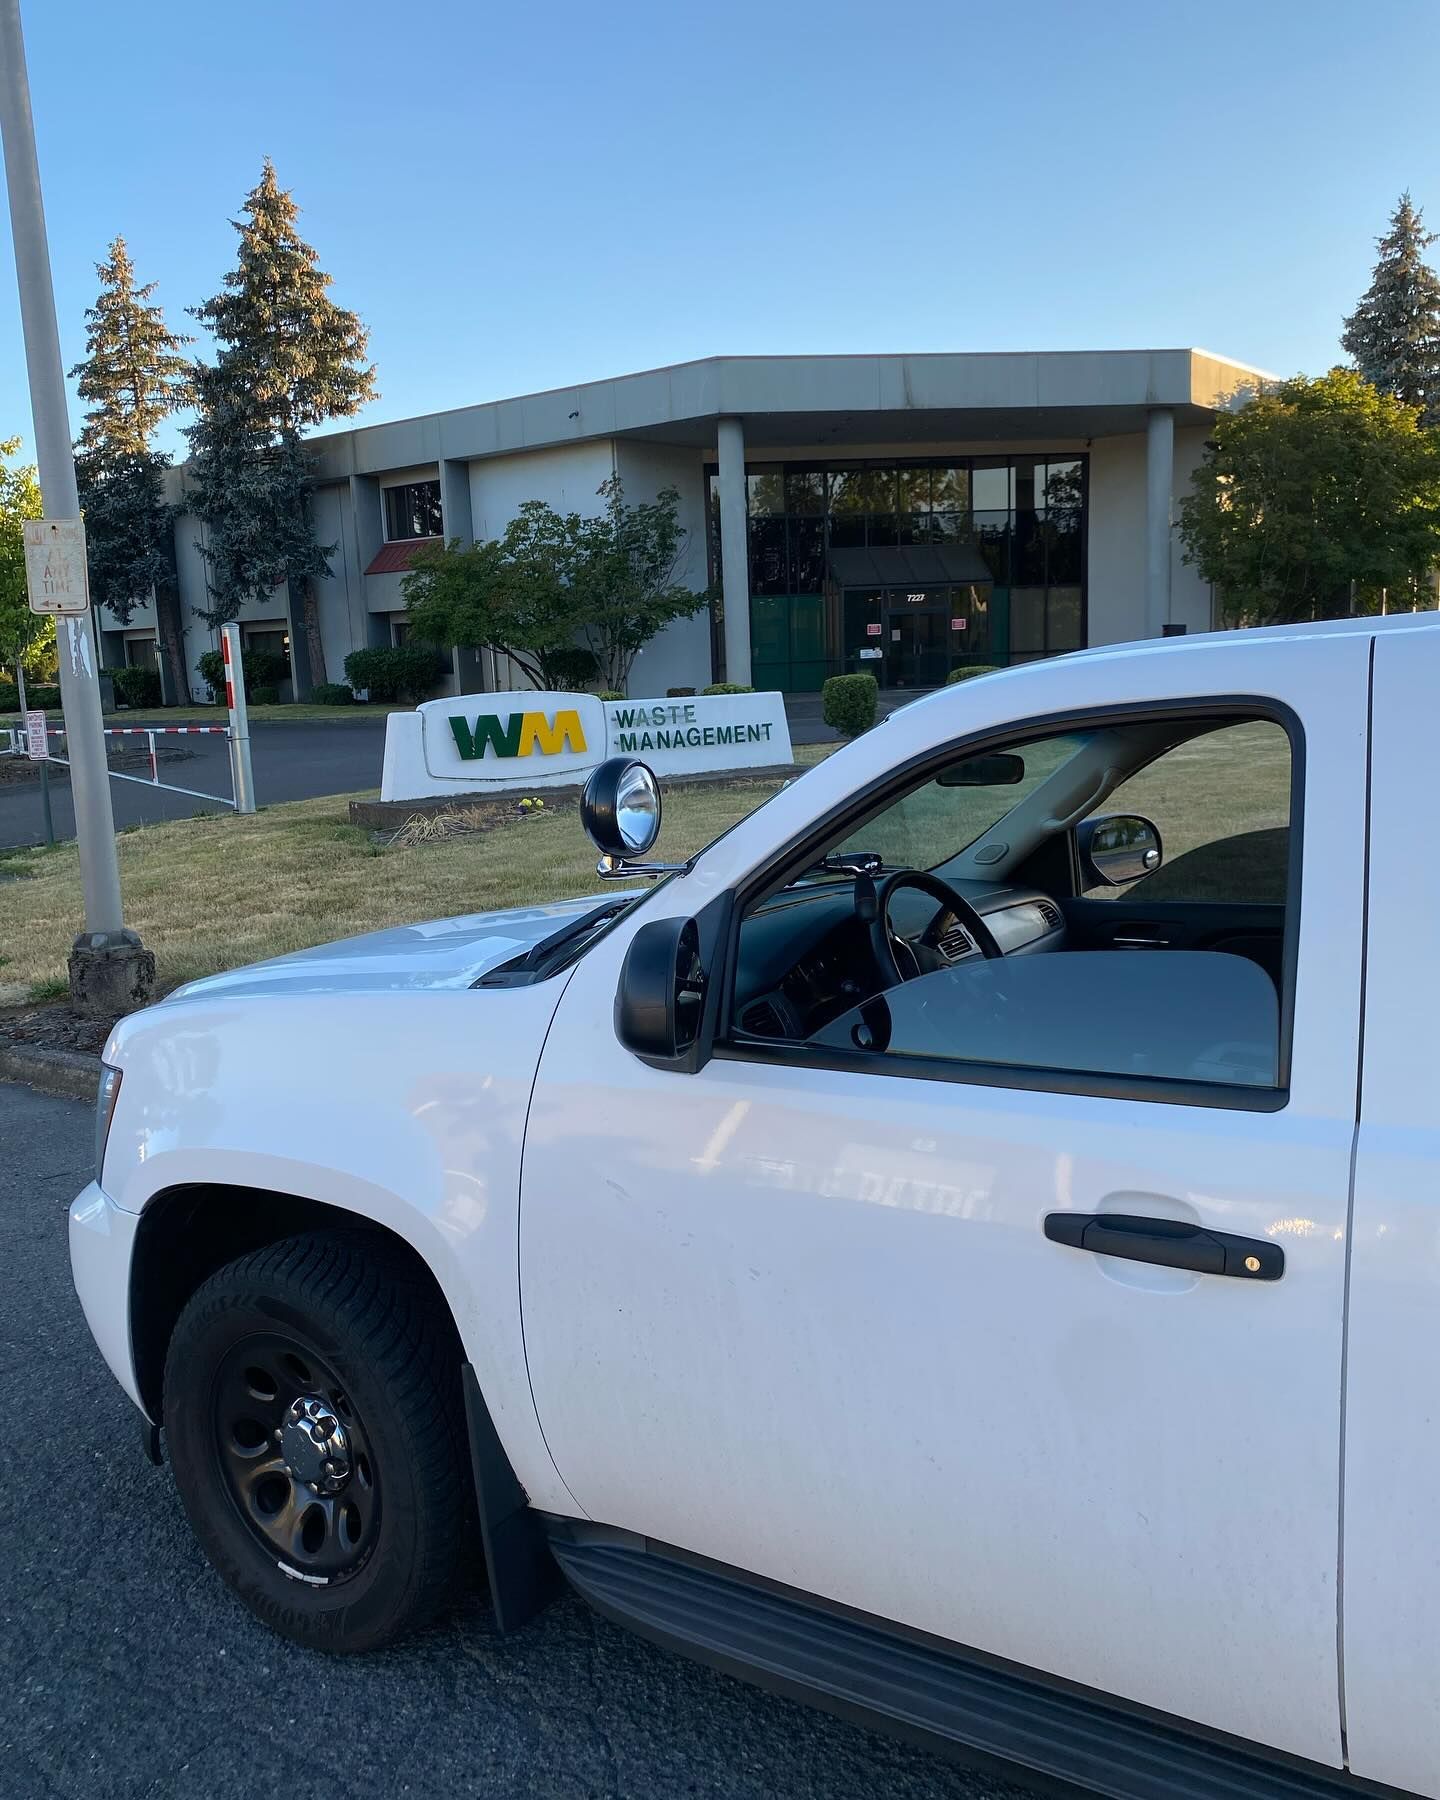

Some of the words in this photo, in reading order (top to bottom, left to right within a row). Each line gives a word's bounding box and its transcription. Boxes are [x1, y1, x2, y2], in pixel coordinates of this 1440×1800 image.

[907, 593, 925, 602] 7227
[615, 705, 696, 729] WASTE
[448, 709, 588, 761] WM
[618, 722, 774, 753] MANAGEMENT
